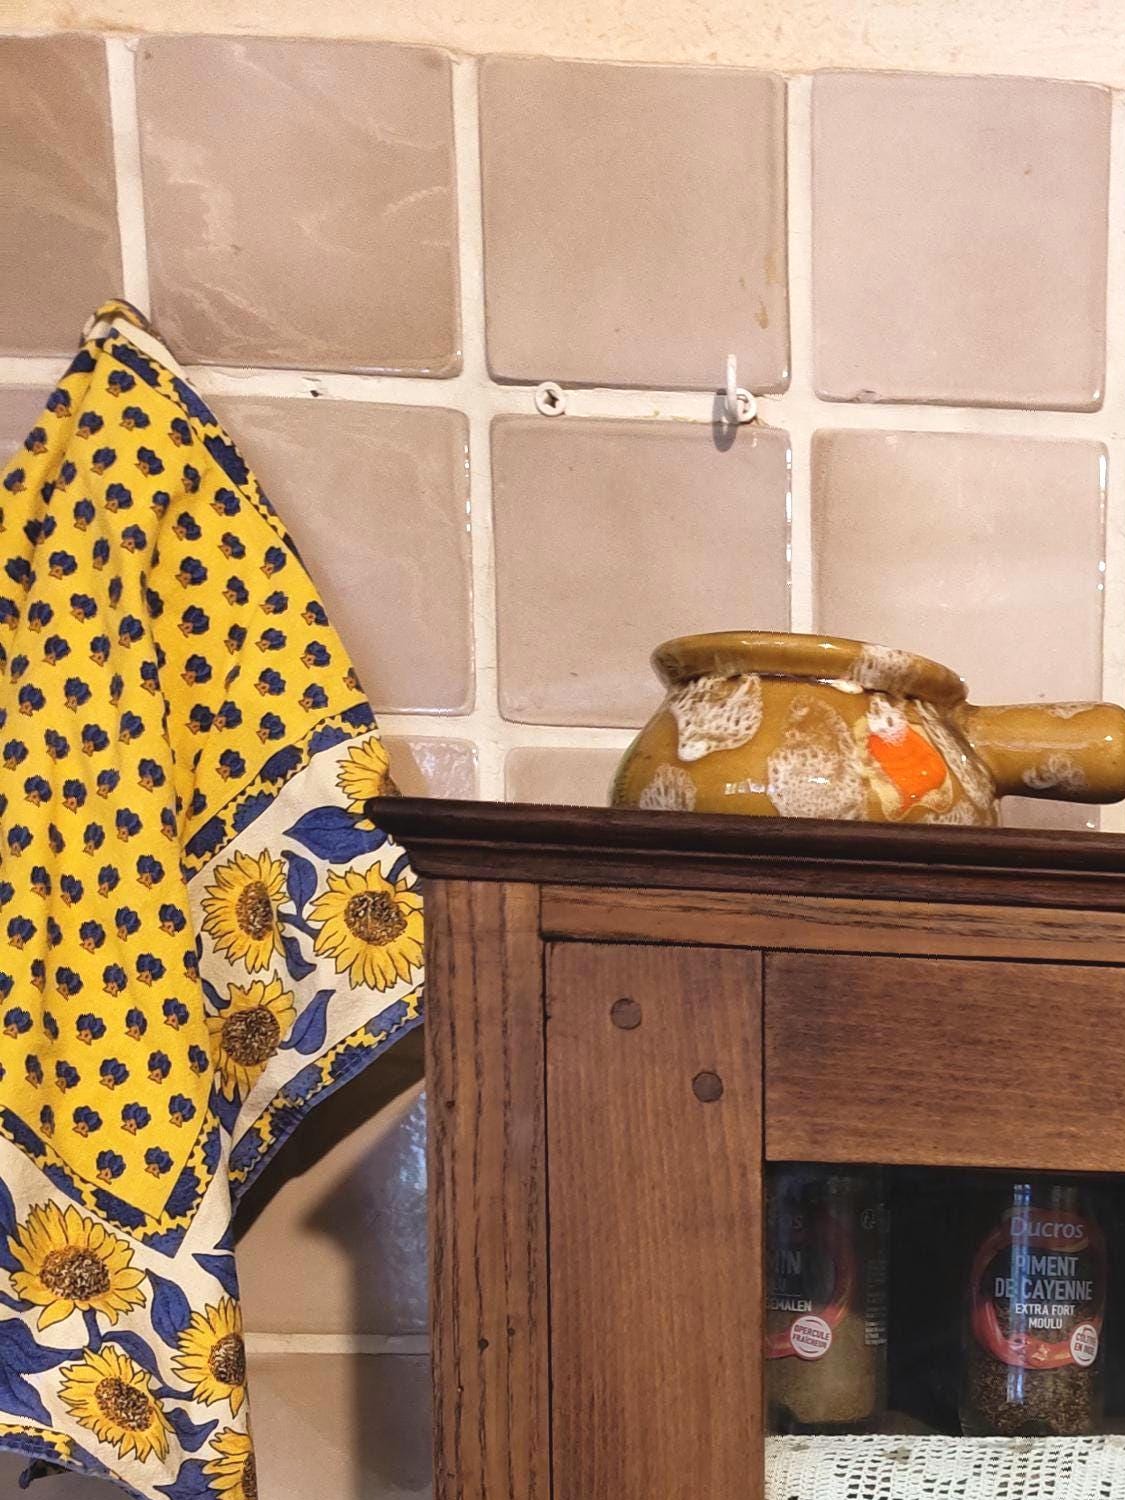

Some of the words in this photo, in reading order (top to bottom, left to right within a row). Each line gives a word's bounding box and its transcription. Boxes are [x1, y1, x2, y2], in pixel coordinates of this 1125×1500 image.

[1010, 1216, 1084, 1239] Ducros
[1015, 1255, 1079, 1277] PIMENT
[995, 1277, 1018, 1298] DE
[1021, 1278, 1093, 1301] CAYENNE
[1015, 1303, 1049, 1316] EXTRA
[1051, 1304, 1075, 1316] FORT
[794, 1324, 831, 1341] OPERCULE
[1028, 1317, 1063, 1330] MOULU
